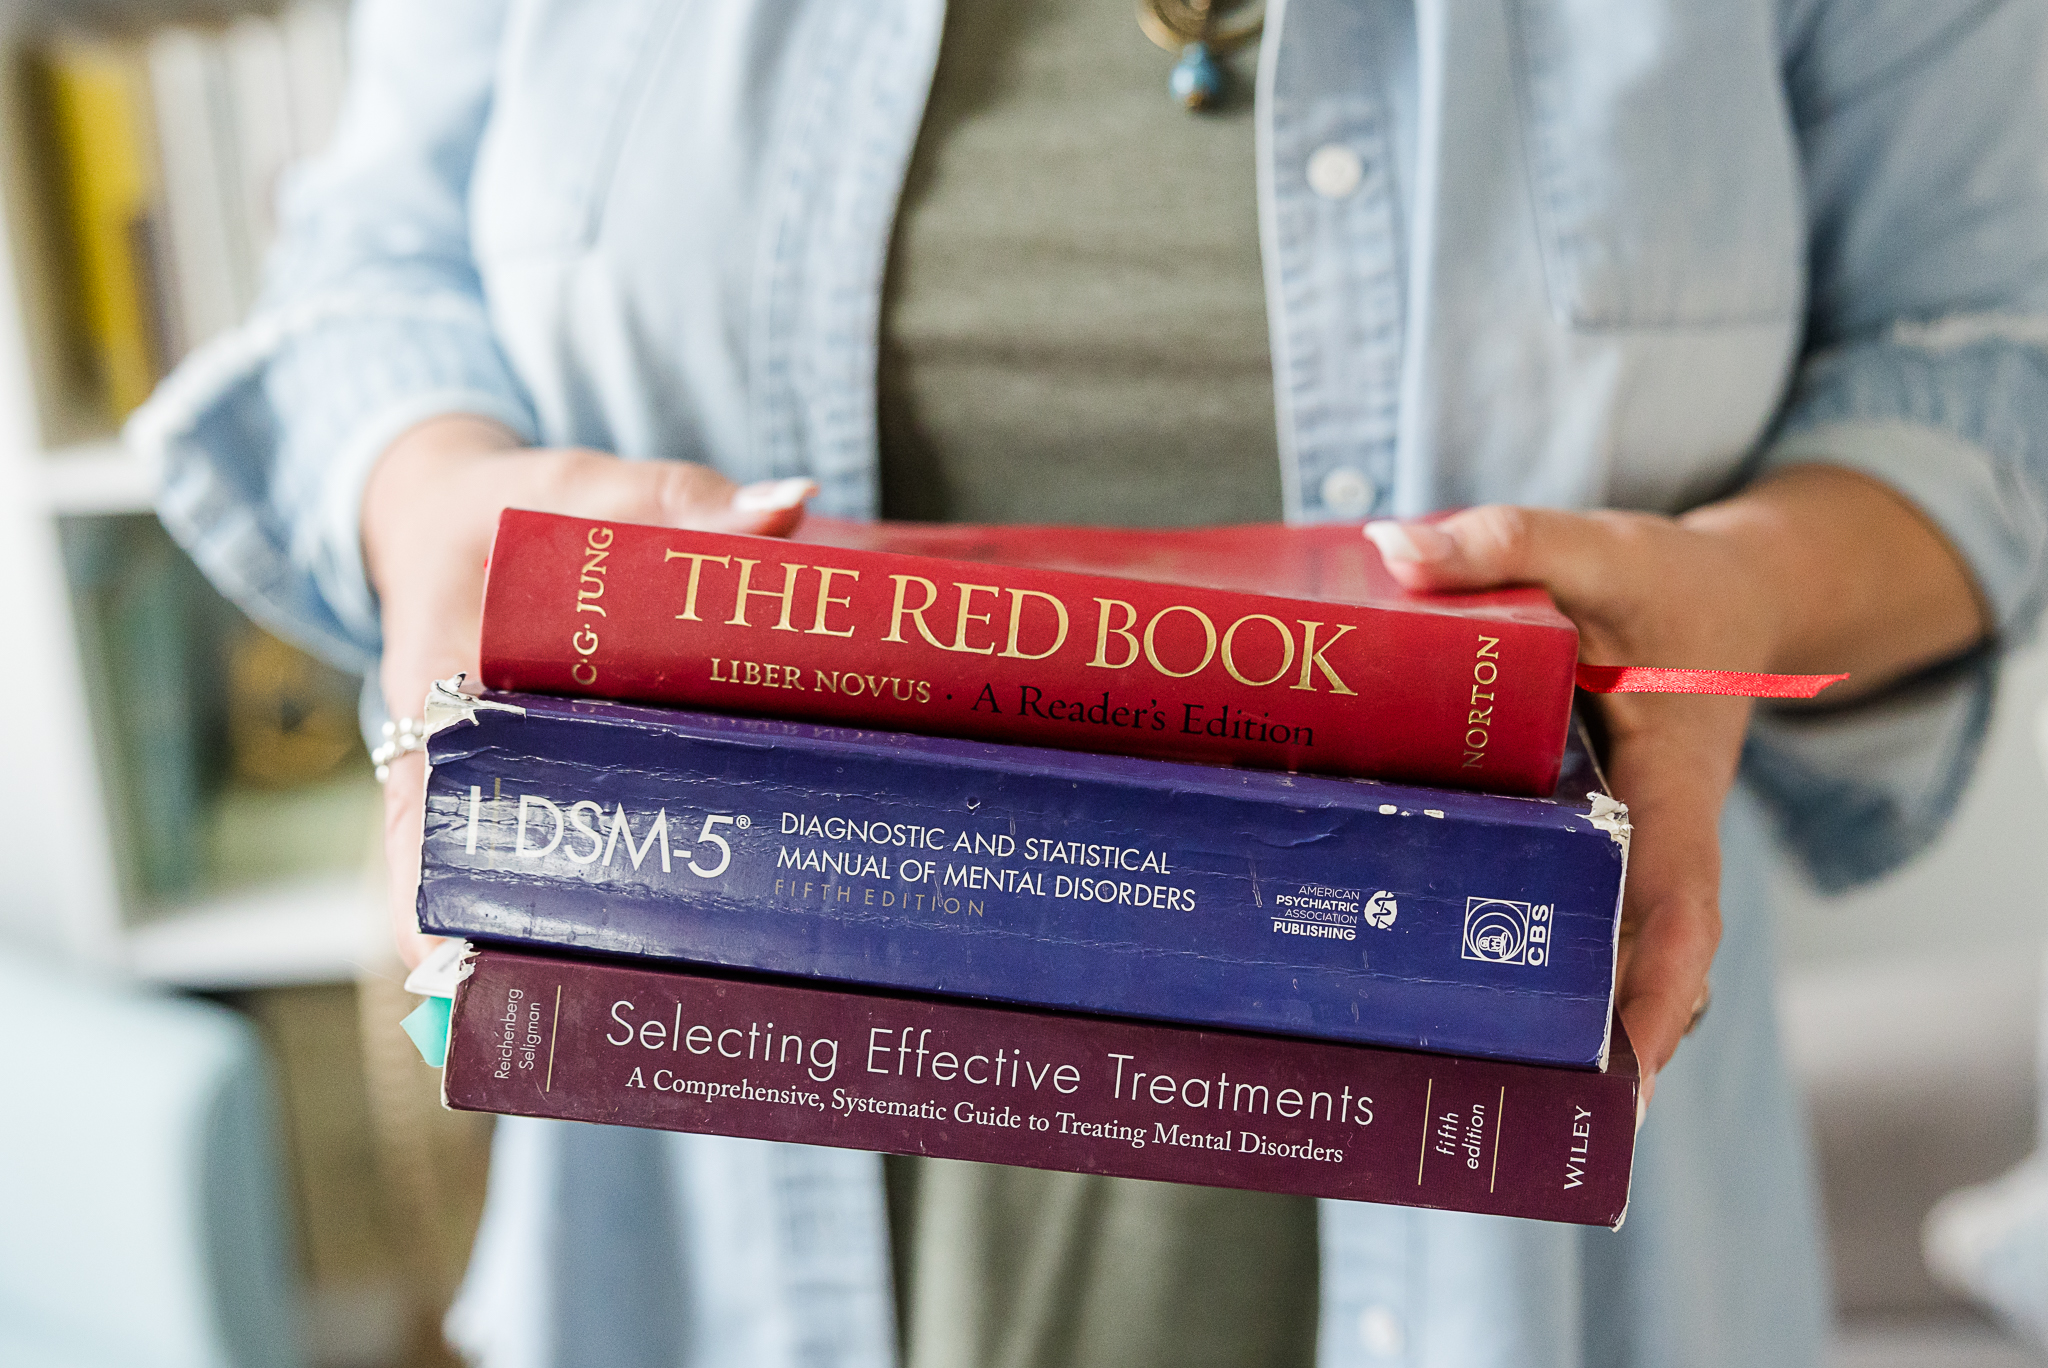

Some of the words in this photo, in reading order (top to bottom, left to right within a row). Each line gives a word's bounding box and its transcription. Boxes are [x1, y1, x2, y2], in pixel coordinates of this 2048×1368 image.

[664, 548, 860, 638] THE
[881, 574, 1069, 661] RED
[1086, 597, 1358, 696] BOOK
[710, 658, 805, 690] LIBER
[814, 669, 931, 703] NOVUS
[971, 683, 1002, 714] A
[1018, 685, 1166, 731] Reader's
[1181, 703, 1314, 746] Edition
[1462, 634, 1500, 769] NORTON
[781, 812, 945, 851] DIAGNOSTIC
[953, 830, 1015, 857] AND
[1024, 838, 1171, 875] STATISTICAL
[774, 878, 851, 902] FIFTH
[864, 889, 985, 917] EDITION
[776, 845, 891, 880] MANUAL
[900, 859, 936, 883] OF
[943, 863, 1047, 896] MENTAL
[1055, 875, 1196, 911] DISORDERS
[1276, 894, 1359, 913] PSYCHIATRIC
[1298, 885, 1360, 900] AMERICAN
[1273, 921, 1356, 941] PUBLISHING
[1285, 908, 1357, 924] ASSOCIATION
[1527, 904, 1549, 966] CBS
[494, 988, 524, 1079] Reichenberg
[519, 1002, 542, 1070] Seligman
[606, 1000, 839, 1082] Selecting
[866, 1026, 1081, 1094] Effective
[1107, 1053, 1374, 1126] Treatments
[625, 1066, 646, 1089] A
[653, 1069, 825, 1112] Comprehensive,
[831, 1088, 947, 1121] Systematic
[953, 1101, 1022, 1129] Guide
[1028, 1114, 1049, 1131] to
[1055, 1111, 1147, 1148] Treating
[1152, 1122, 1232, 1152] Mental
[1238, 1131, 1344, 1163] Disorders
[1435, 1112, 1459, 1155] fifth
[1461, 1103, 1485, 1170] edition
[1563, 1104, 1592, 1190] WILEY
